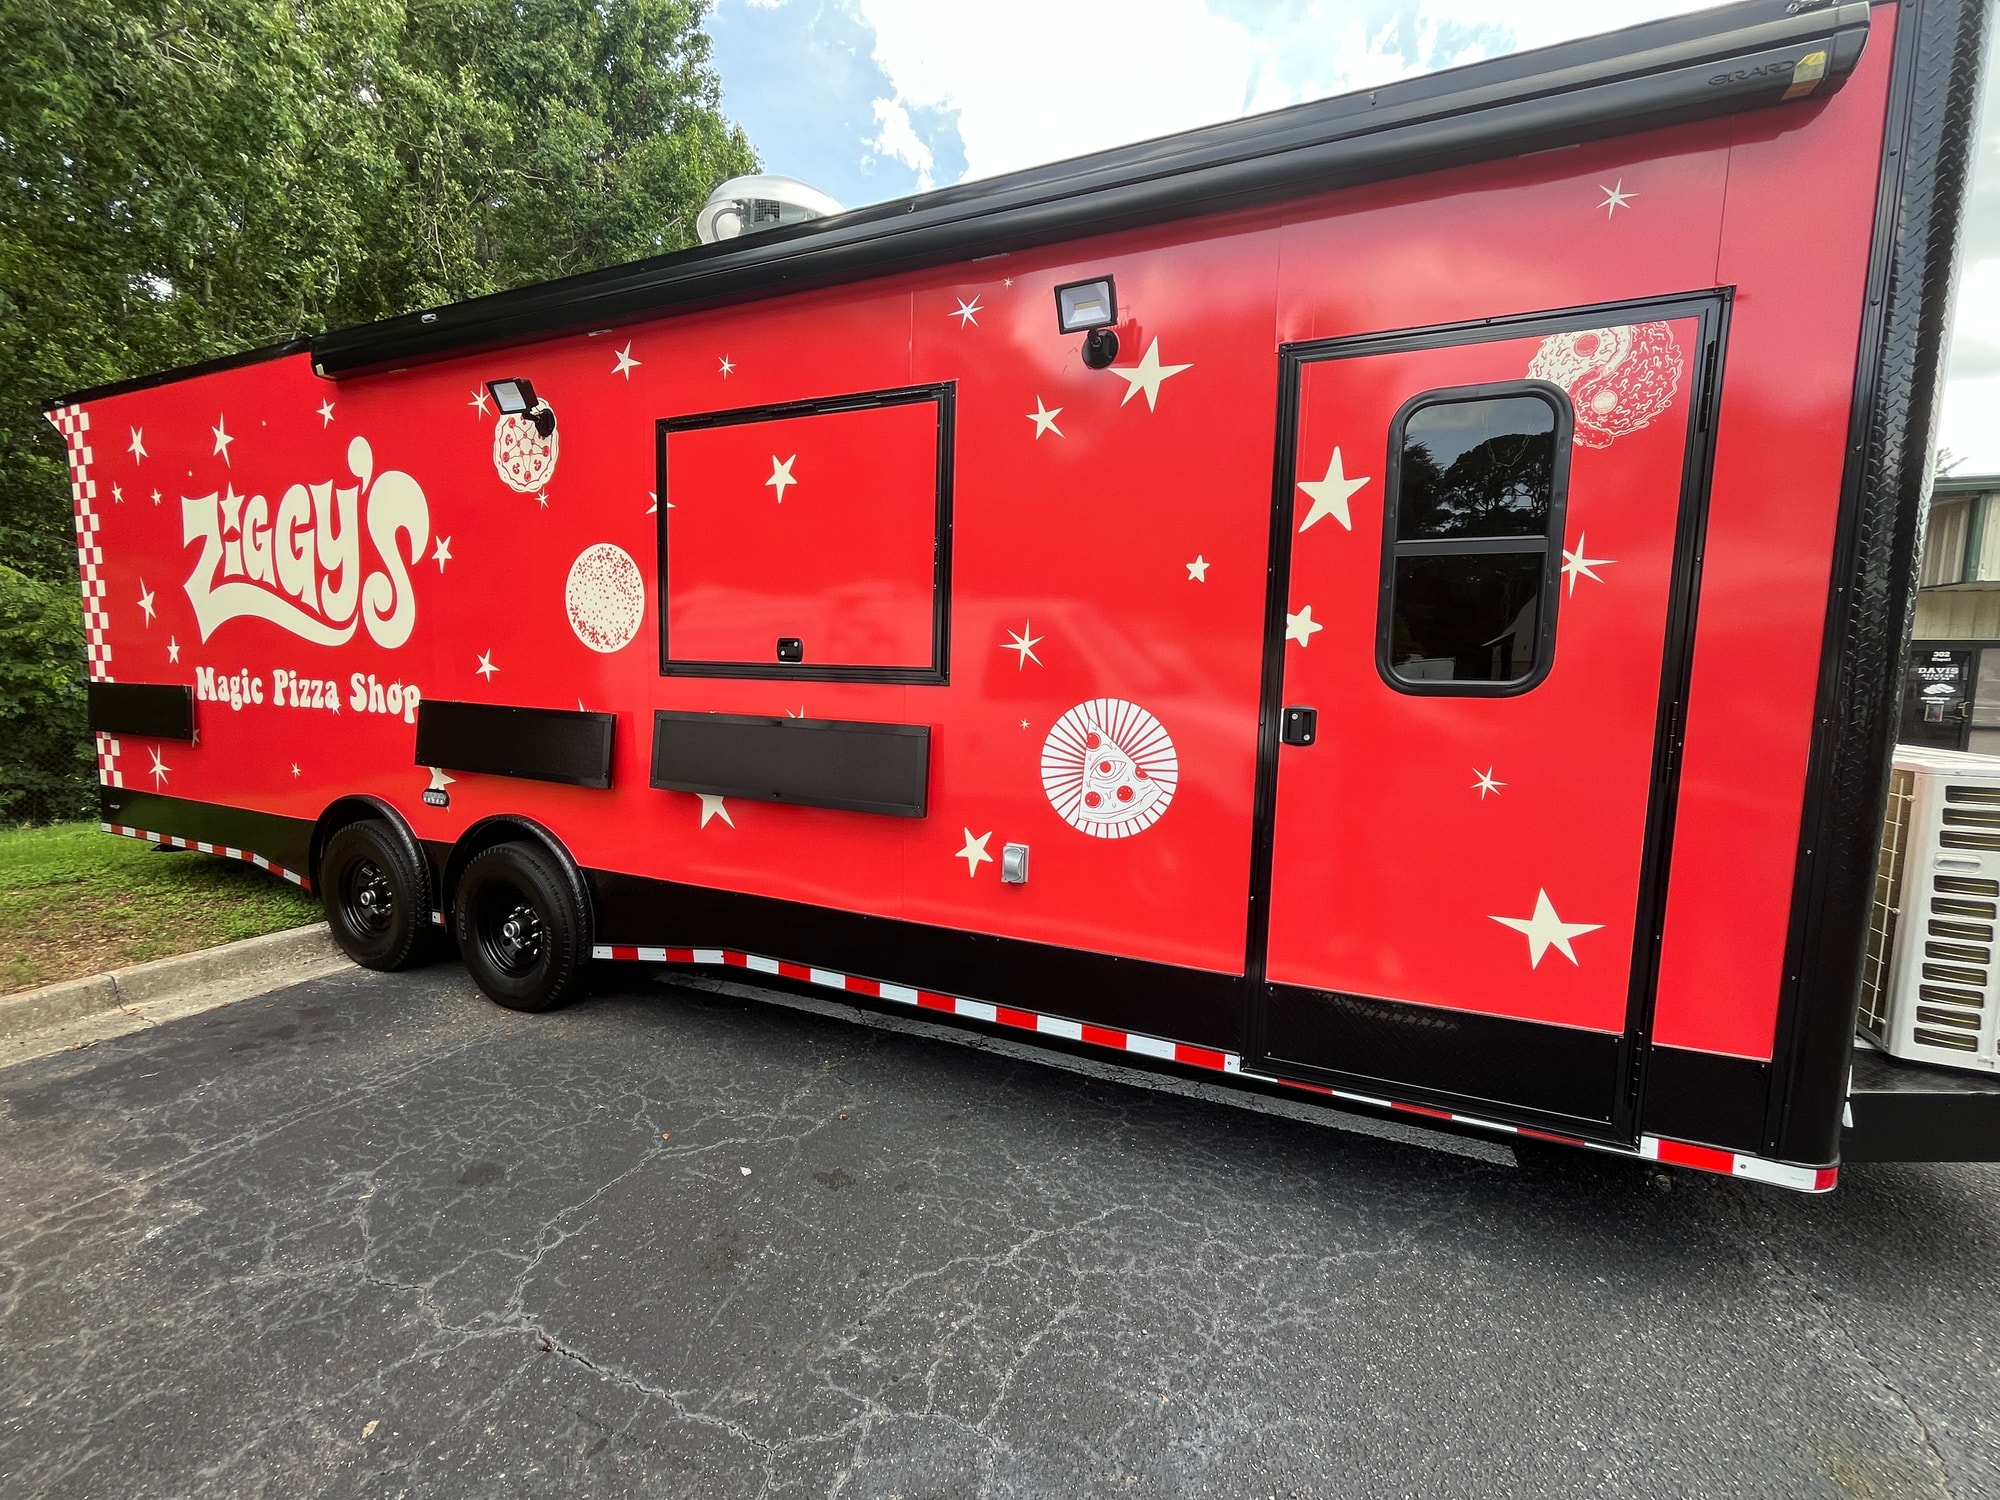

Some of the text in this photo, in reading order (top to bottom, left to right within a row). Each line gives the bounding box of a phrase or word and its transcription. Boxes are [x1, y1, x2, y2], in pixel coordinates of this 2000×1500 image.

[1708, 60, 1794, 85] GIRARD
[181, 435, 430, 650] ZIGGY'S
[195, 666, 422, 724] Magic Pizza Shop
